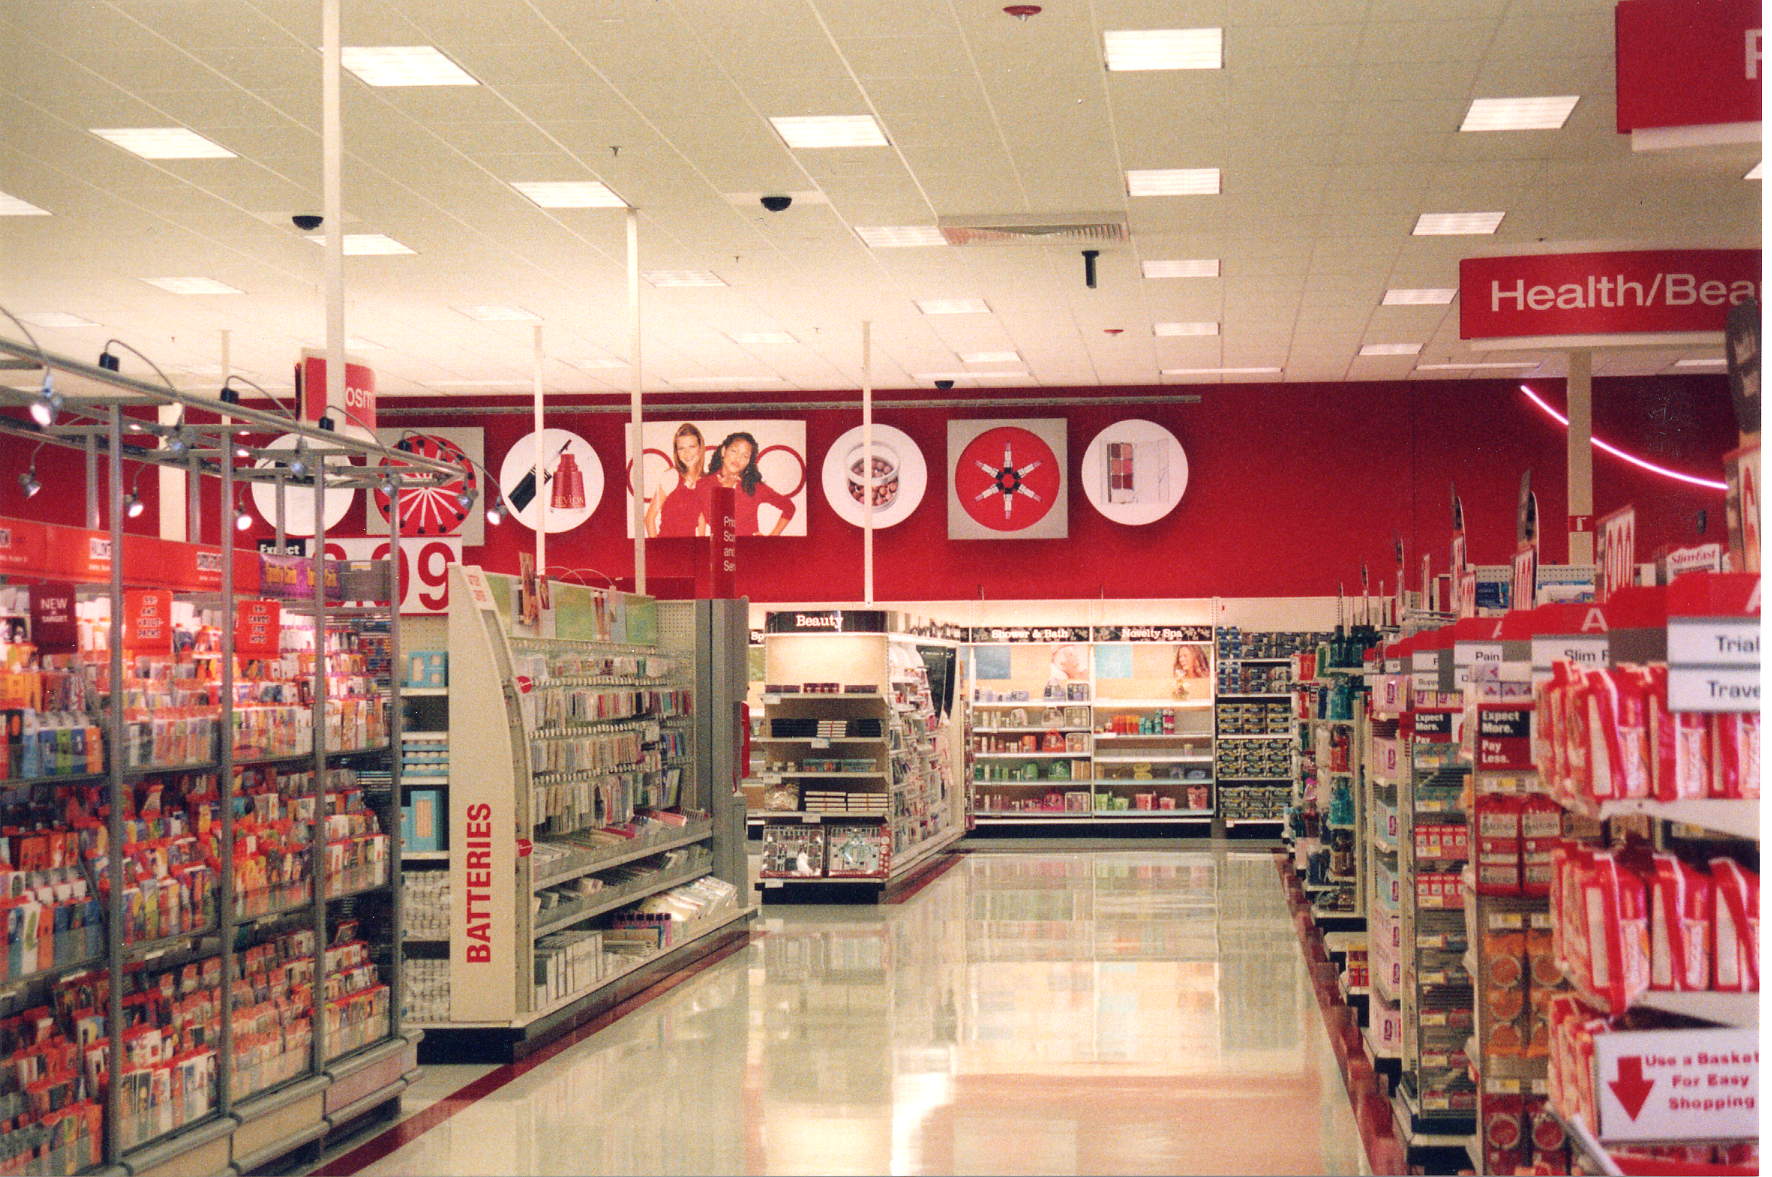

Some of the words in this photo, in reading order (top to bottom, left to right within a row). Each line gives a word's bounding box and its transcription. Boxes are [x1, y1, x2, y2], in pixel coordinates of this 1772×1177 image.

[1491, 272, 1762, 312] Health/Bea
[258, 542, 300, 555] Exct
[40, 598, 68, 610] NEW
[796, 614, 843, 628] Beauty
[991, 629, 1030, 639] Shower
[1032, 629, 1042, 638] &
[1044, 629, 1069, 638] Bath
[1121, 628, 1161, 639] Novelty
[1162, 629, 1183, 640] Spa
[1475, 651, 1500, 662] Pain
[1415, 713, 1444, 723] Expect
[1482, 710, 1521, 723] Expect
[1415, 722, 1440, 731] More.
[1482, 722, 1514, 734] More.
[1482, 739, 1501, 752] Pay
[1482, 753, 1510, 764] Less.
[466, 803, 491, 963] BATTERIES
[1645, 1055, 1677, 1067] Use
[1682, 1056, 1693, 1066] a
[1672, 1074, 1700, 1088] For
[1707, 1073, 1750, 1088] Easy
[1669, 1096, 1755, 1111] Shopping
